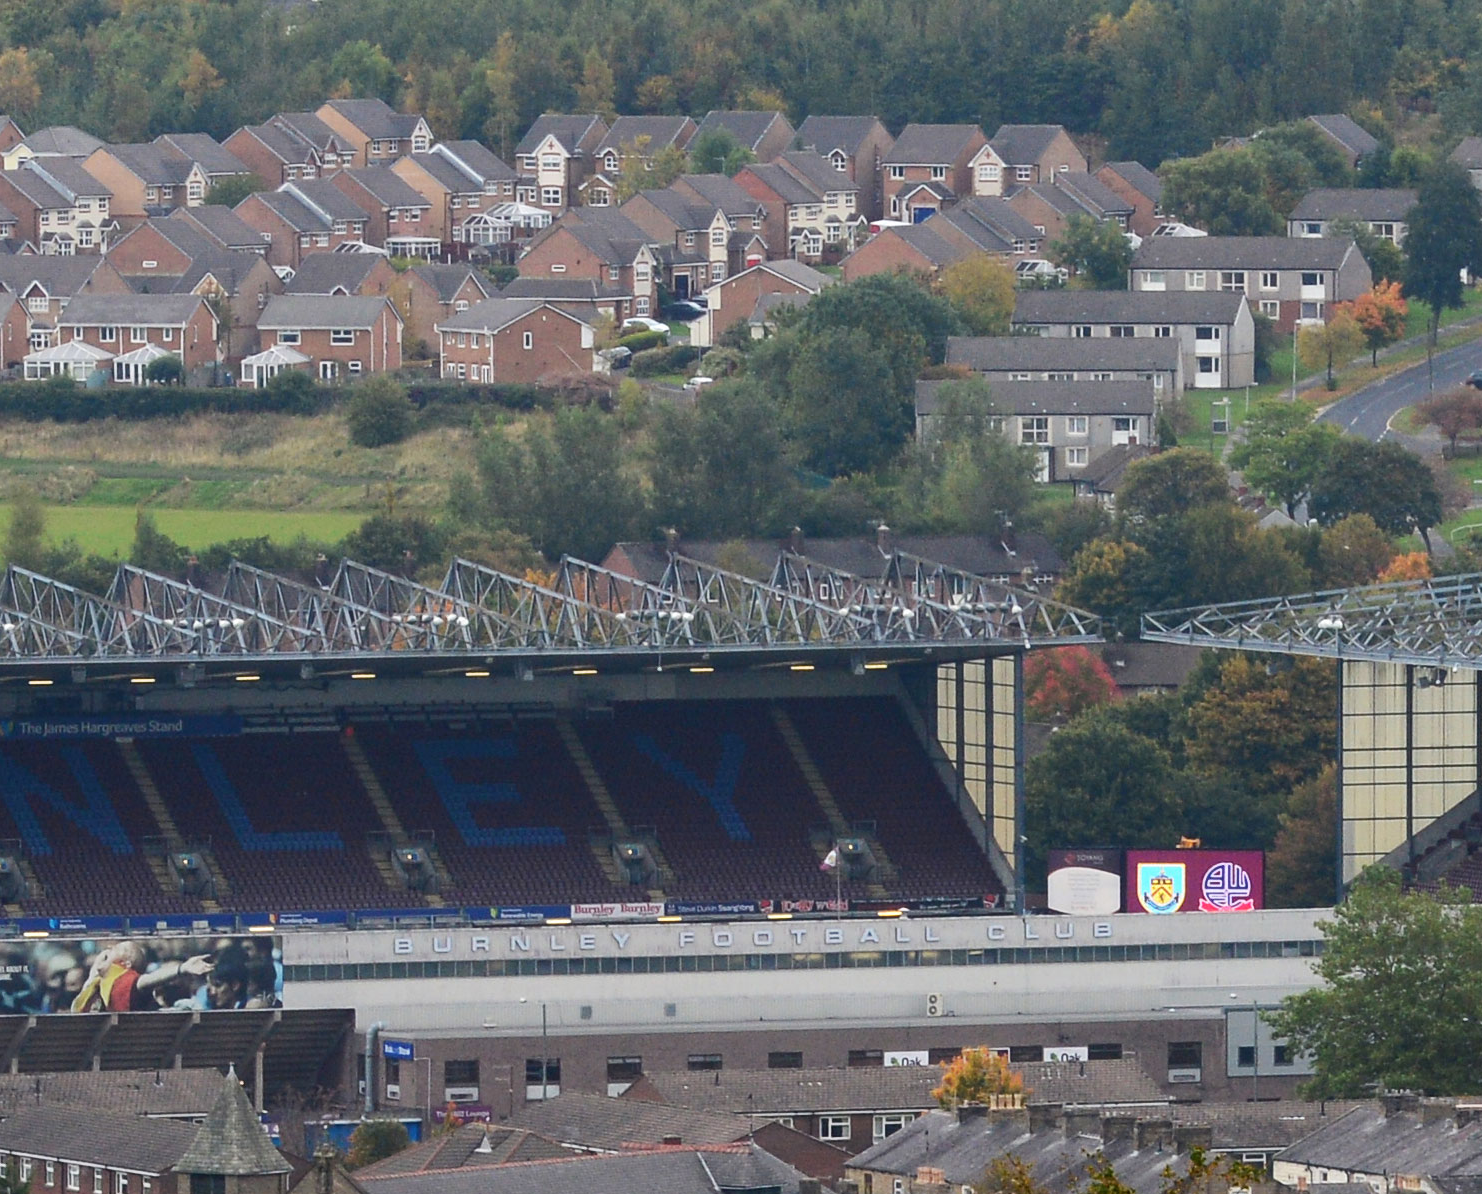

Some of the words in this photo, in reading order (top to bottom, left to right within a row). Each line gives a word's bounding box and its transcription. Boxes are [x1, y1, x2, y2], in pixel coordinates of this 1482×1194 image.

[20, 722, 42, 734] The
[43, 722, 79, 737] James
[81, 721, 147, 737] Hargreaves
[149, 720, 183, 733] Stand
[574, 904, 615, 915] Burnley
[621, 902, 662, 914] Burnley
[394, 932, 631, 953] BURNLEY
[679, 925, 940, 947] FOOTBALL
[987, 922, 1115, 940] CLUB
[901, 1057, 922, 1066] Oak
[1061, 1053, 1082, 1061] Oak
